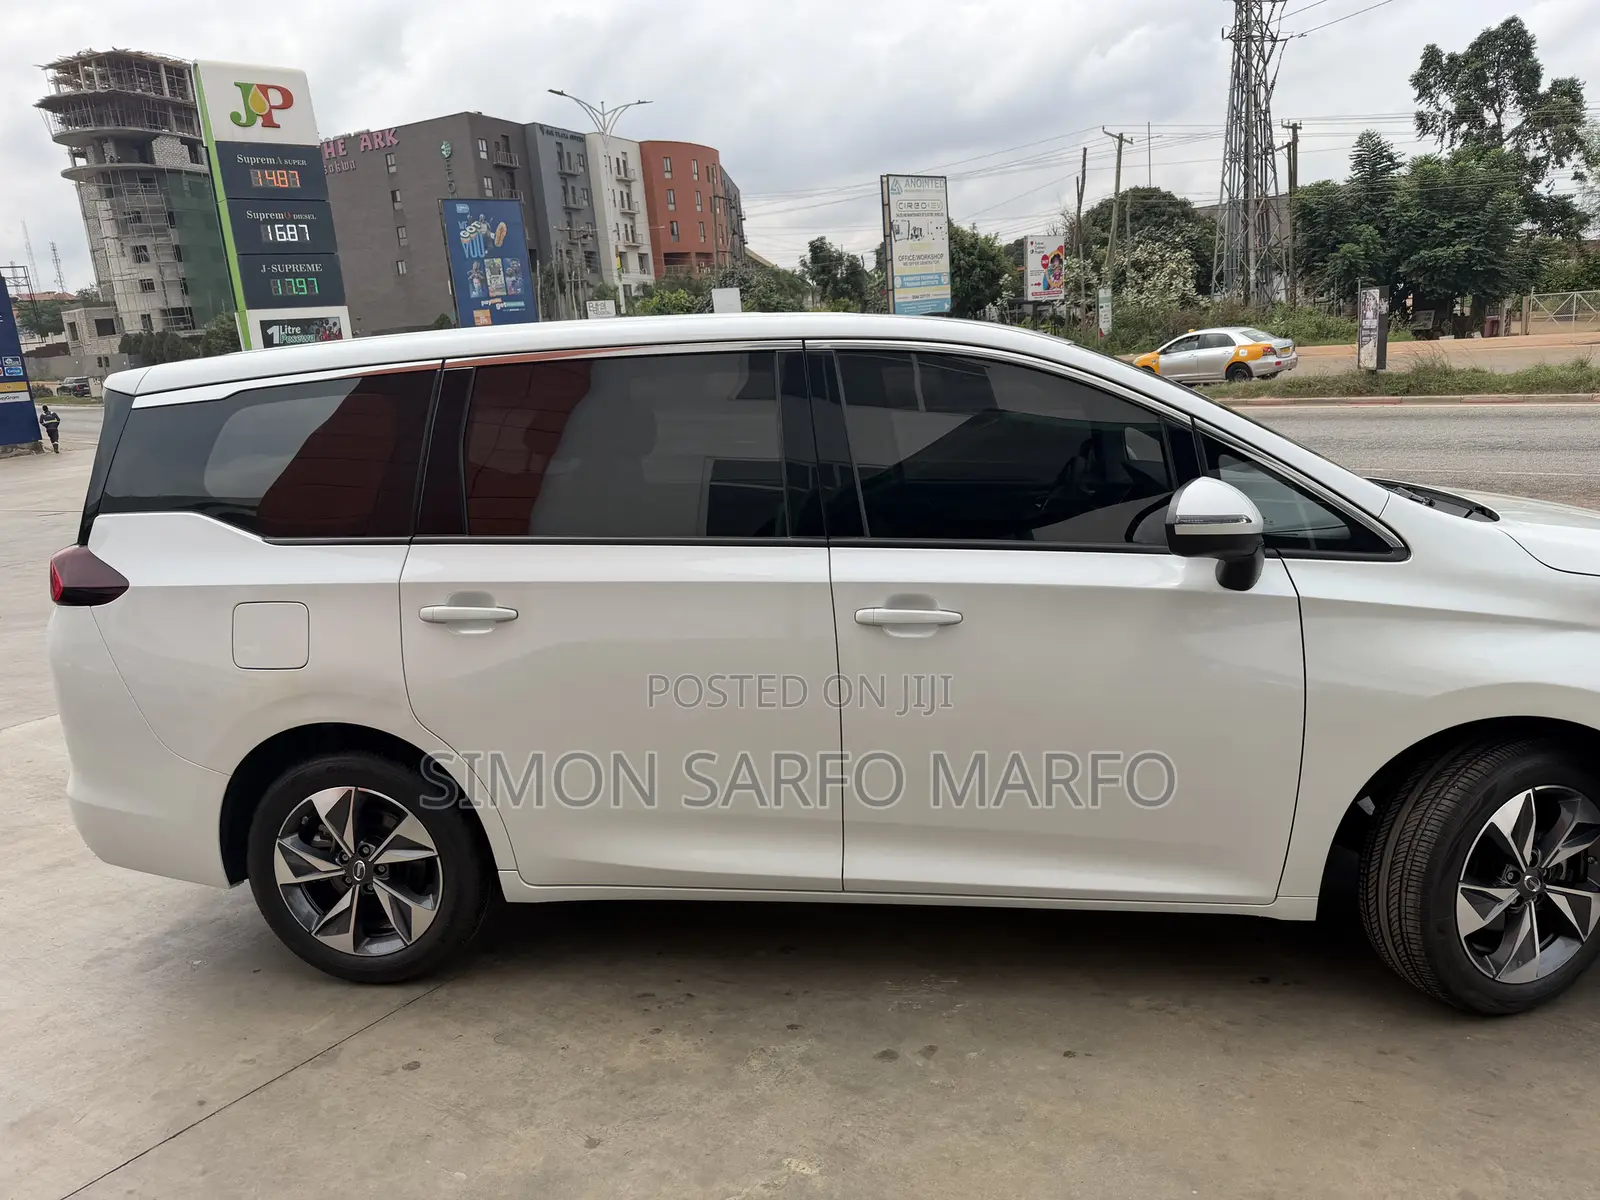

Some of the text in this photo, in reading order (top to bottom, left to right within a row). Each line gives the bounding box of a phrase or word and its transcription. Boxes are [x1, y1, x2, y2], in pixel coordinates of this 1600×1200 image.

[229, 81, 294, 128] JP
[359, 128, 401, 152] ARK
[283, 158, 308, 167] SUPER
[903, 177, 946, 189] ANOINTED
[459, 220, 482, 240] GOT
[260, 263, 323, 273] J-SUPREME
[266, 325, 302, 344] 1 Litre
